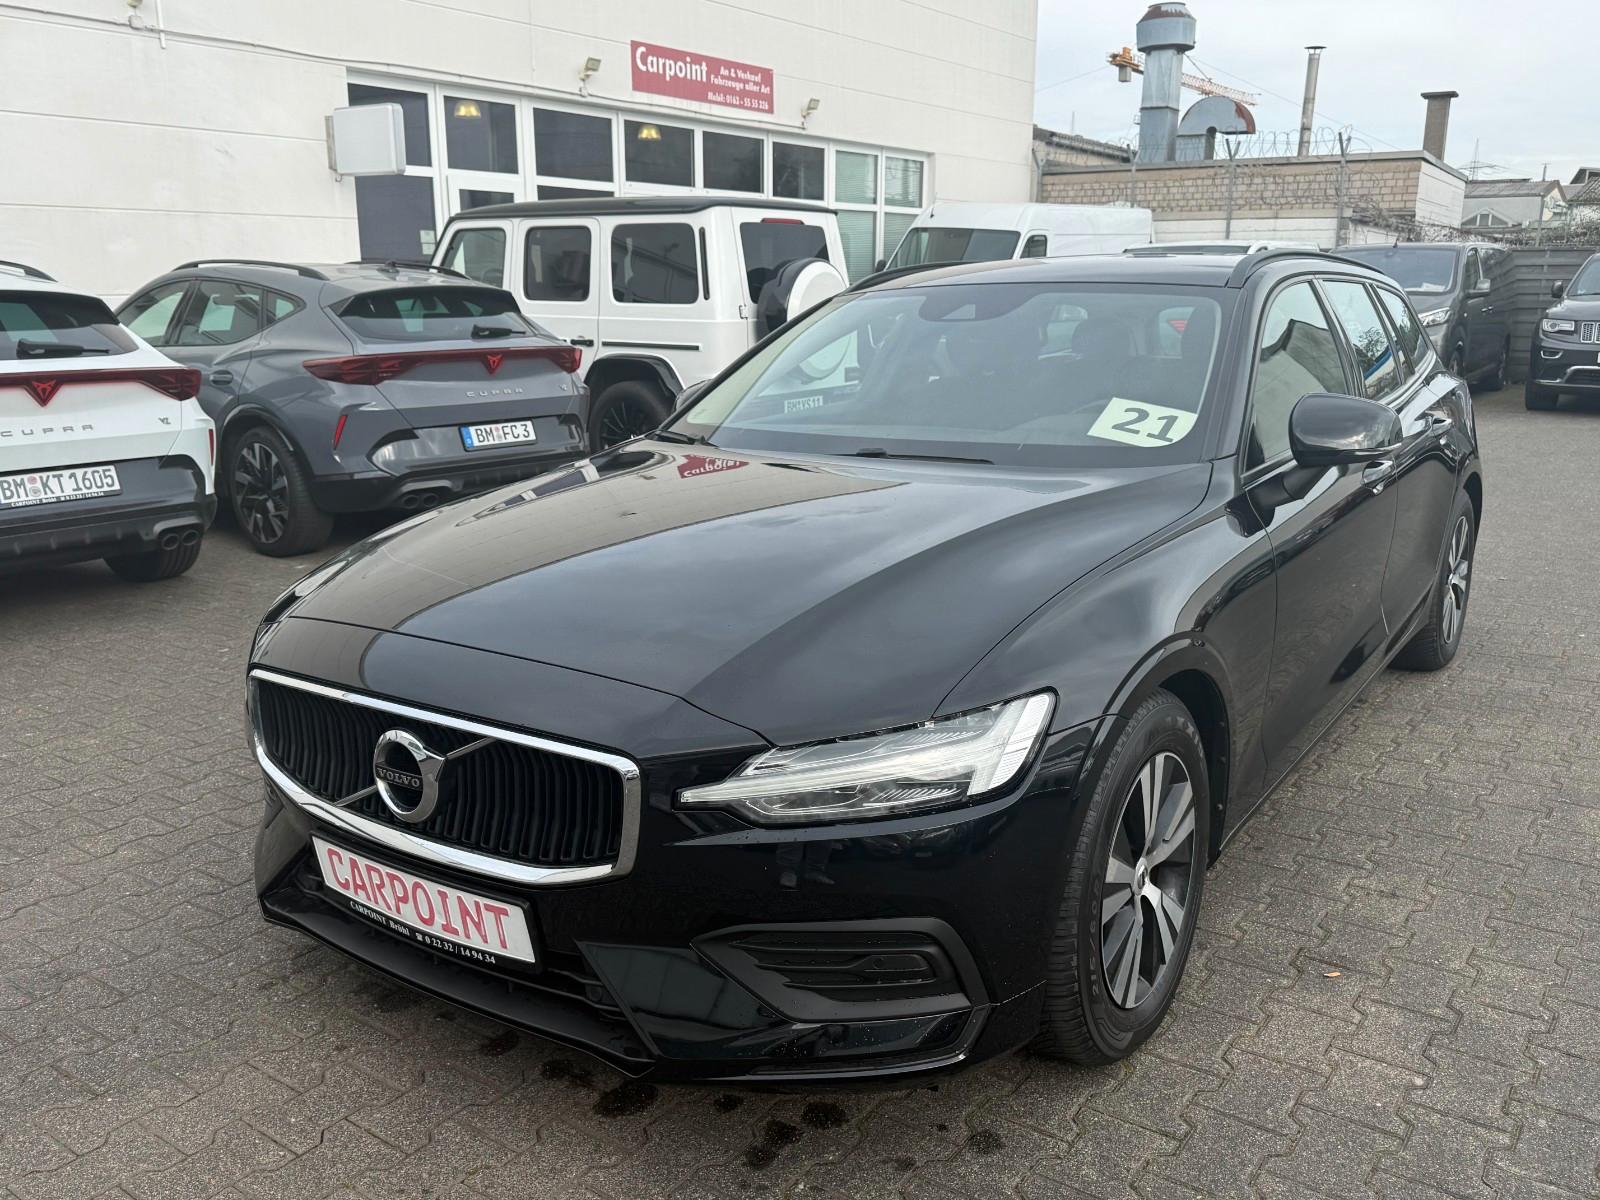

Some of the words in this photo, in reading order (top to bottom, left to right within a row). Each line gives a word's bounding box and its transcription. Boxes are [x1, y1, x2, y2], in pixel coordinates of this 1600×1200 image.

[636, 46, 707, 82] Carpoint
[720, 66, 730, 76] An
[730, 68, 736, 77] &
[710, 75, 744, 91] Fahrzeuge
[745, 82, 760, 92] aller
[466, 387, 523, 397] CUPRA
[0, 424, 94, 437] CUPRA
[474, 427, 495, 443] BM
[501, 424, 520, 440] FC
[521, 423, 531, 438] 3
[1111, 407, 1179, 443] 21
[0, 477, 29, 500] BM
[40, 474, 65, 496] KT
[68, 468, 116, 493] 1605
[377, 767, 420, 787] VOLVO
[327, 847, 511, 950] CARPOINT
[350, 900, 387, 925] CARPOINT
[389, 920, 410, 936] Brühl
[425, 935, 431, 944] 0
[432, 937, 442, 948] 22
[443, 941, 454, 952] 32
[460, 947, 471, 957] 14
[471, 950, 483, 961] 94
[484, 953, 496, 964] 34
